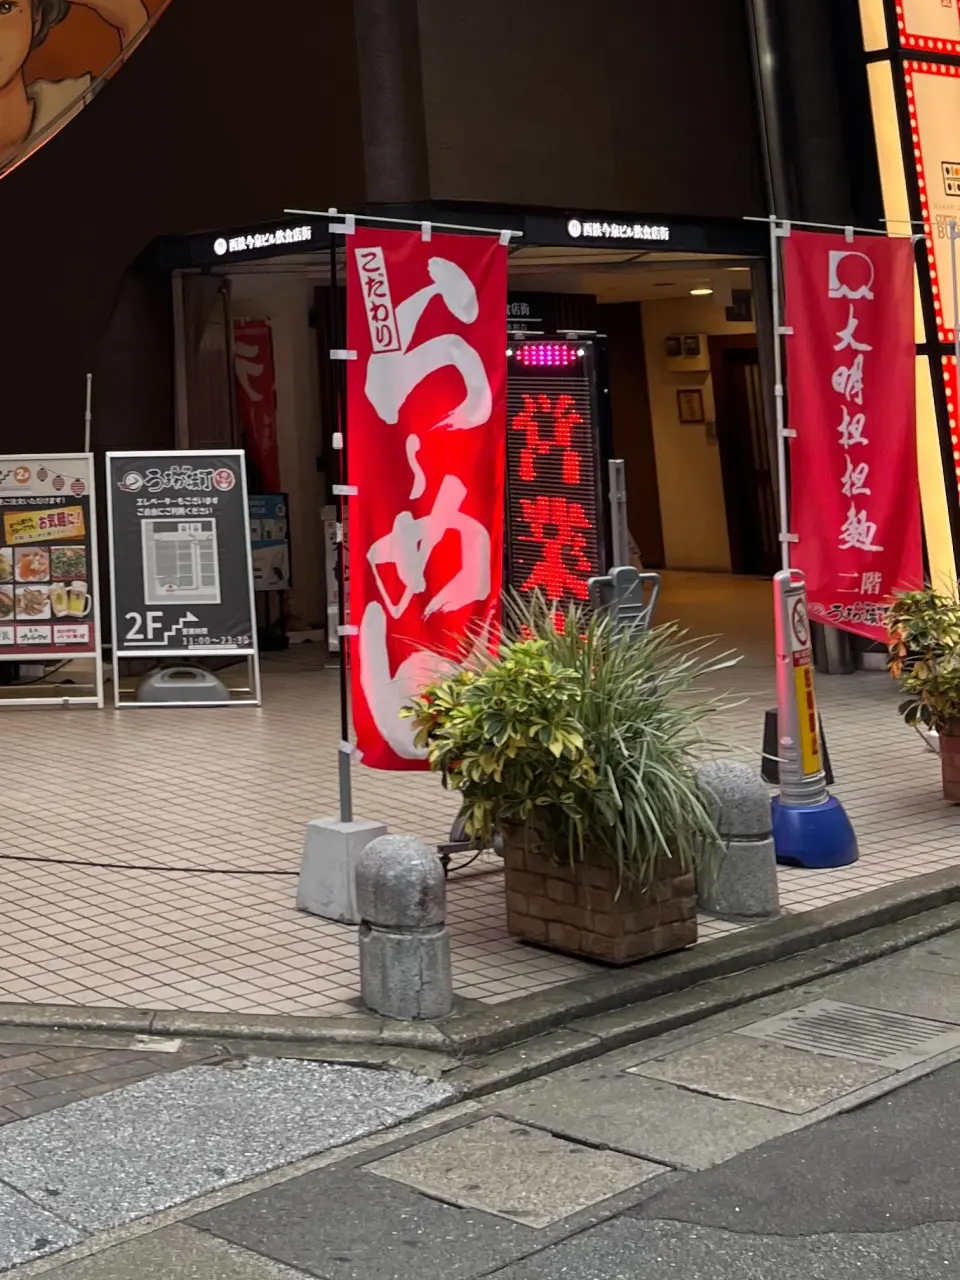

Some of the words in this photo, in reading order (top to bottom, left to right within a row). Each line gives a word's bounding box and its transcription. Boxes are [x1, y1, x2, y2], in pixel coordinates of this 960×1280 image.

[361, 251, 392, 347] こだわり
[143, 468, 215, 493] うまか横丁
[836, 571, 882, 596] 二階
[124, 610, 164, 640] 2F
